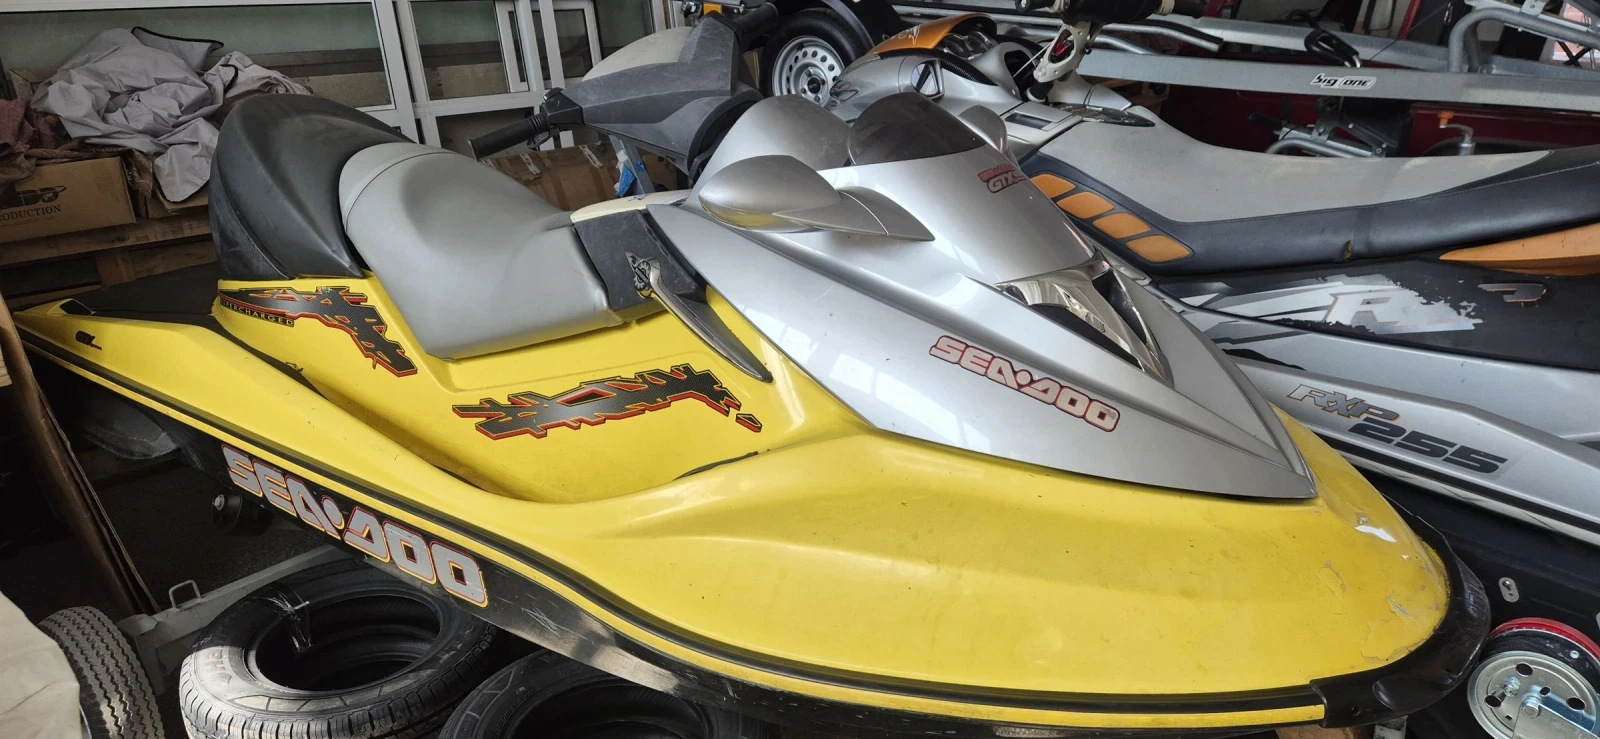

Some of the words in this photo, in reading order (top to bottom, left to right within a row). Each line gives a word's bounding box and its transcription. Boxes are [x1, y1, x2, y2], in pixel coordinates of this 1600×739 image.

[220, 300, 294, 326] PERCHARGED
[1286, 389, 1400, 422] RXP
[1347, 416, 1509, 474] 255
